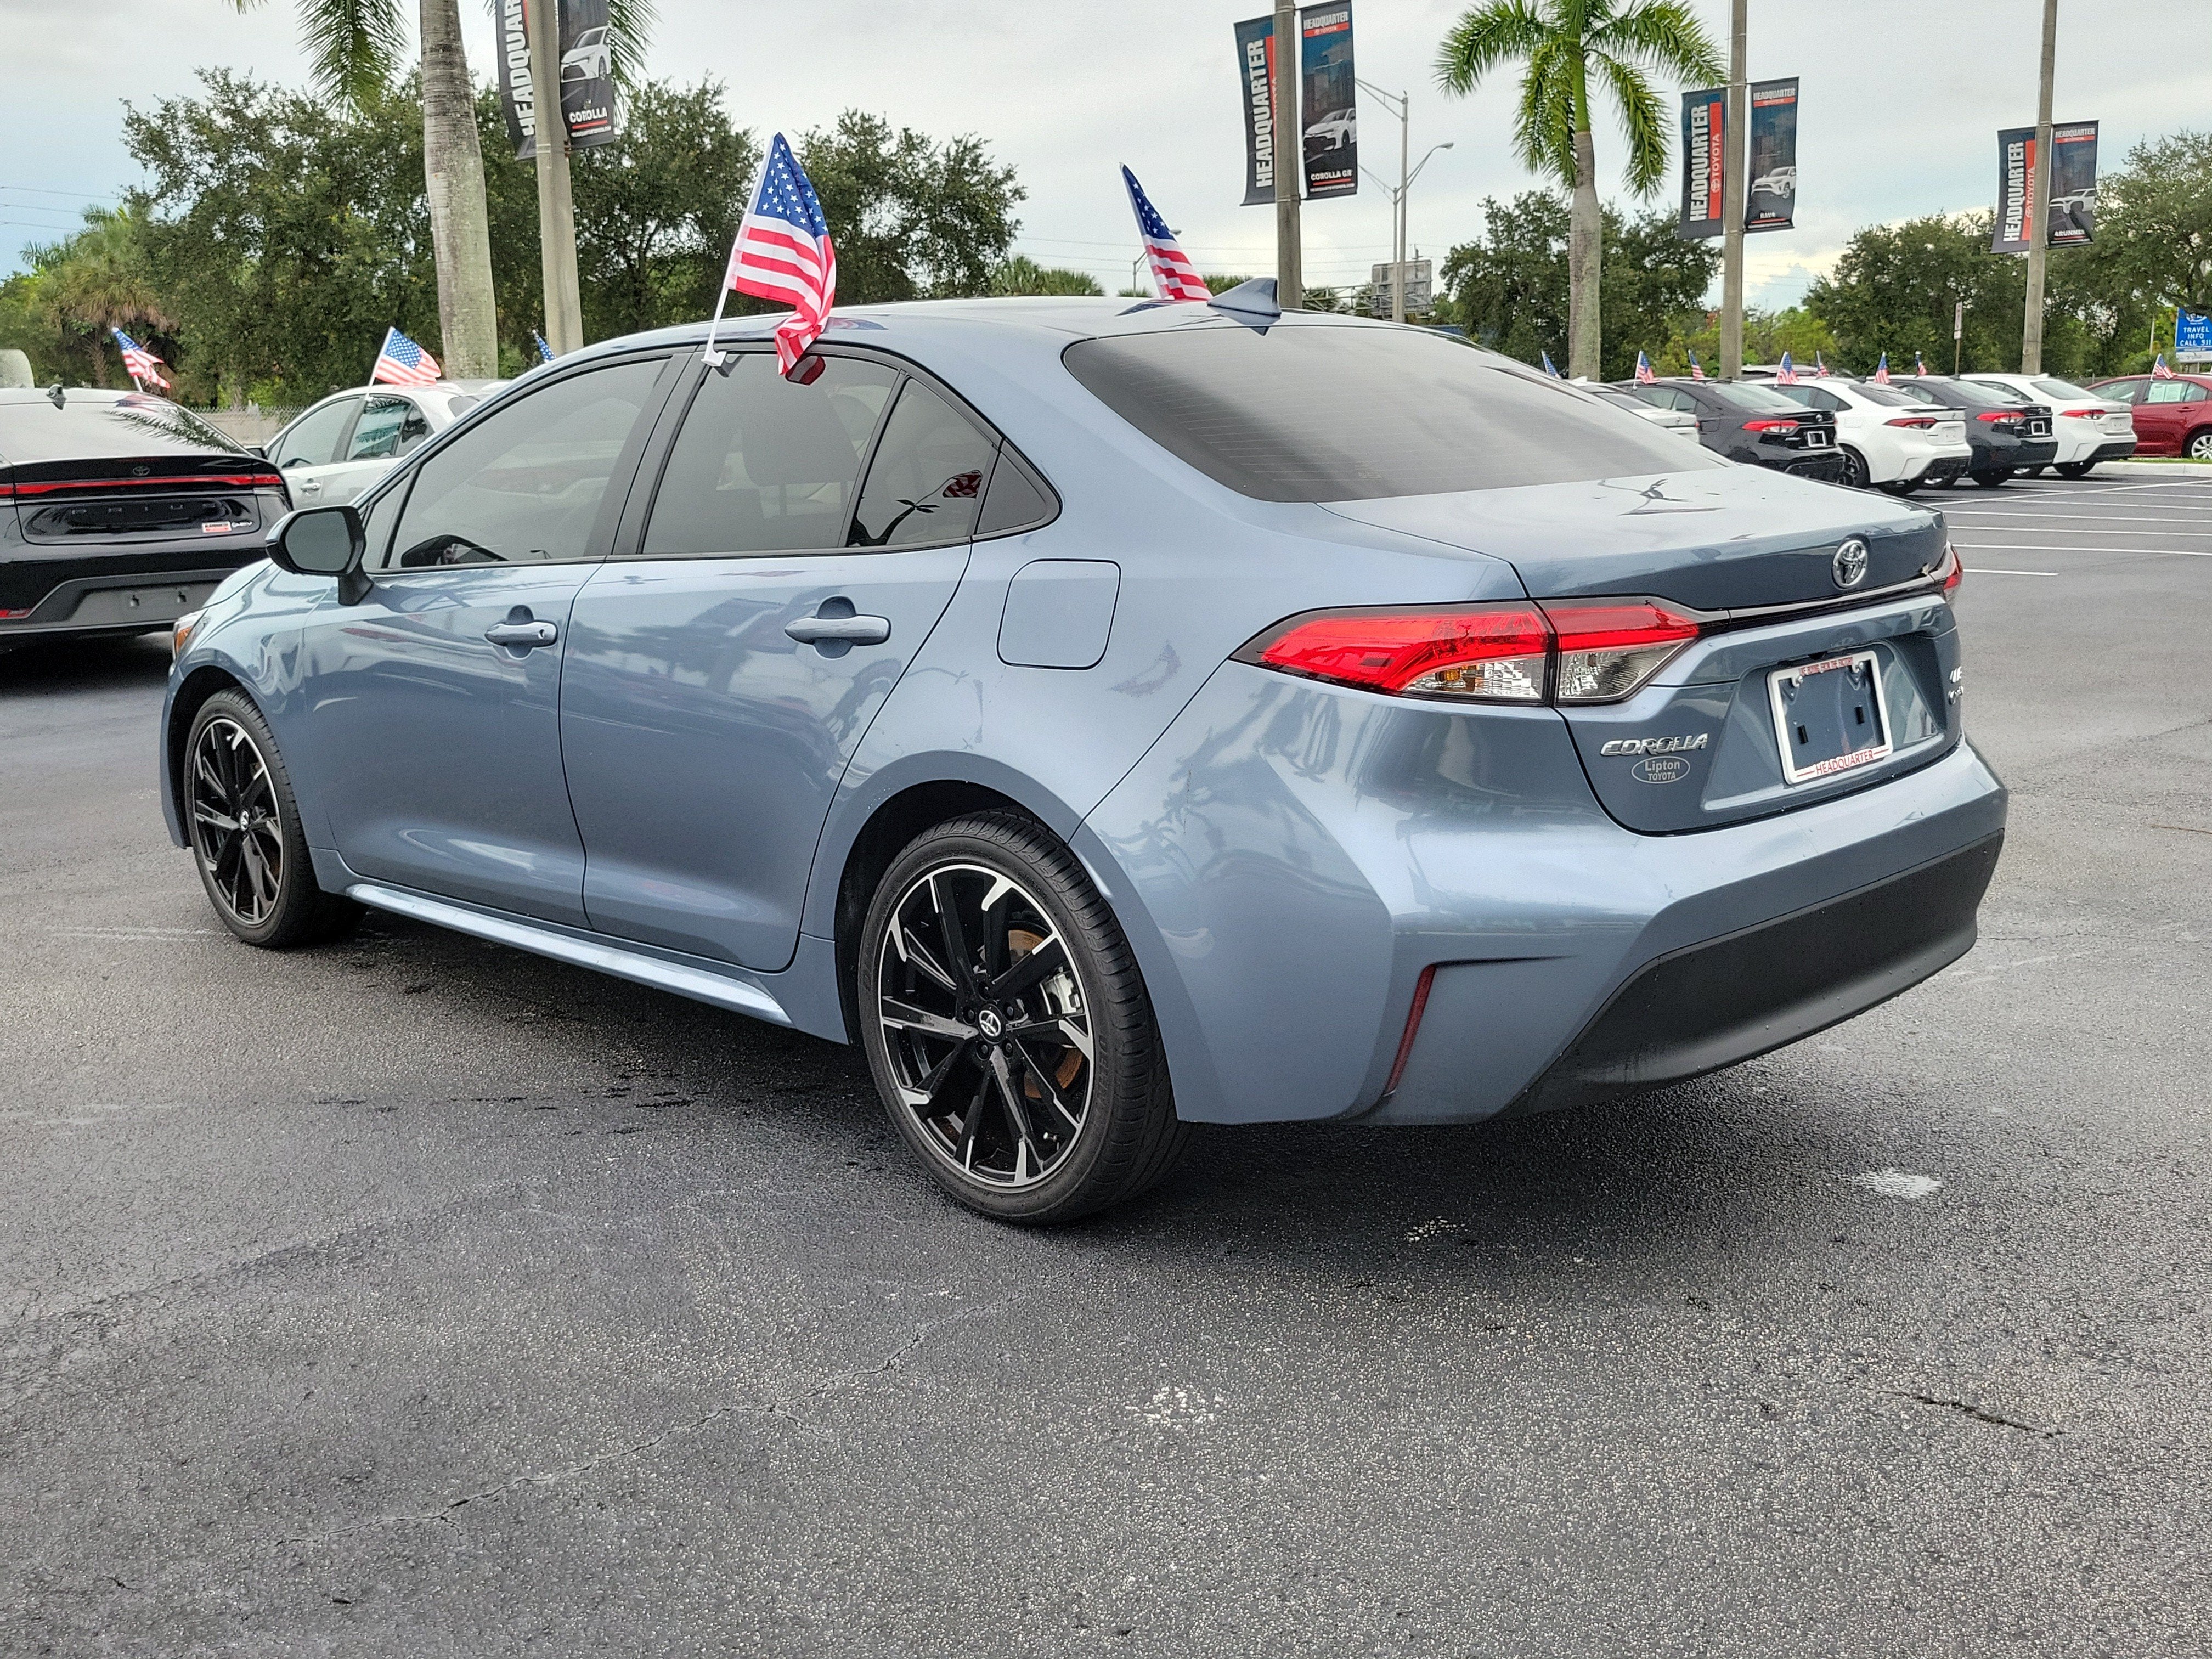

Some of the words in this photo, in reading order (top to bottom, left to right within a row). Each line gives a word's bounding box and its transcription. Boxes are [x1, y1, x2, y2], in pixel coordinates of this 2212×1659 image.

[1304, 11, 1348, 30] HEADQUARTER
[569, 106, 608, 123] COROLLA
[1247, 40, 1273, 188] HEADQUARTER
[1689, 105, 1710, 221] HEADQUARTER
[1712, 134, 1721, 177] TOYOTA
[1311, 170, 1341, 180] COROLLA
[1342, 169, 1353, 177] GR
[2002, 142, 2025, 242] HEADQUARTER
[1600, 733, 1708, 756] COROLLA
[1645, 760, 1680, 772] Lipton
[1815, 750, 1874, 775] HEADQUARTER
[1648, 772, 1676, 781] TOYOTA
